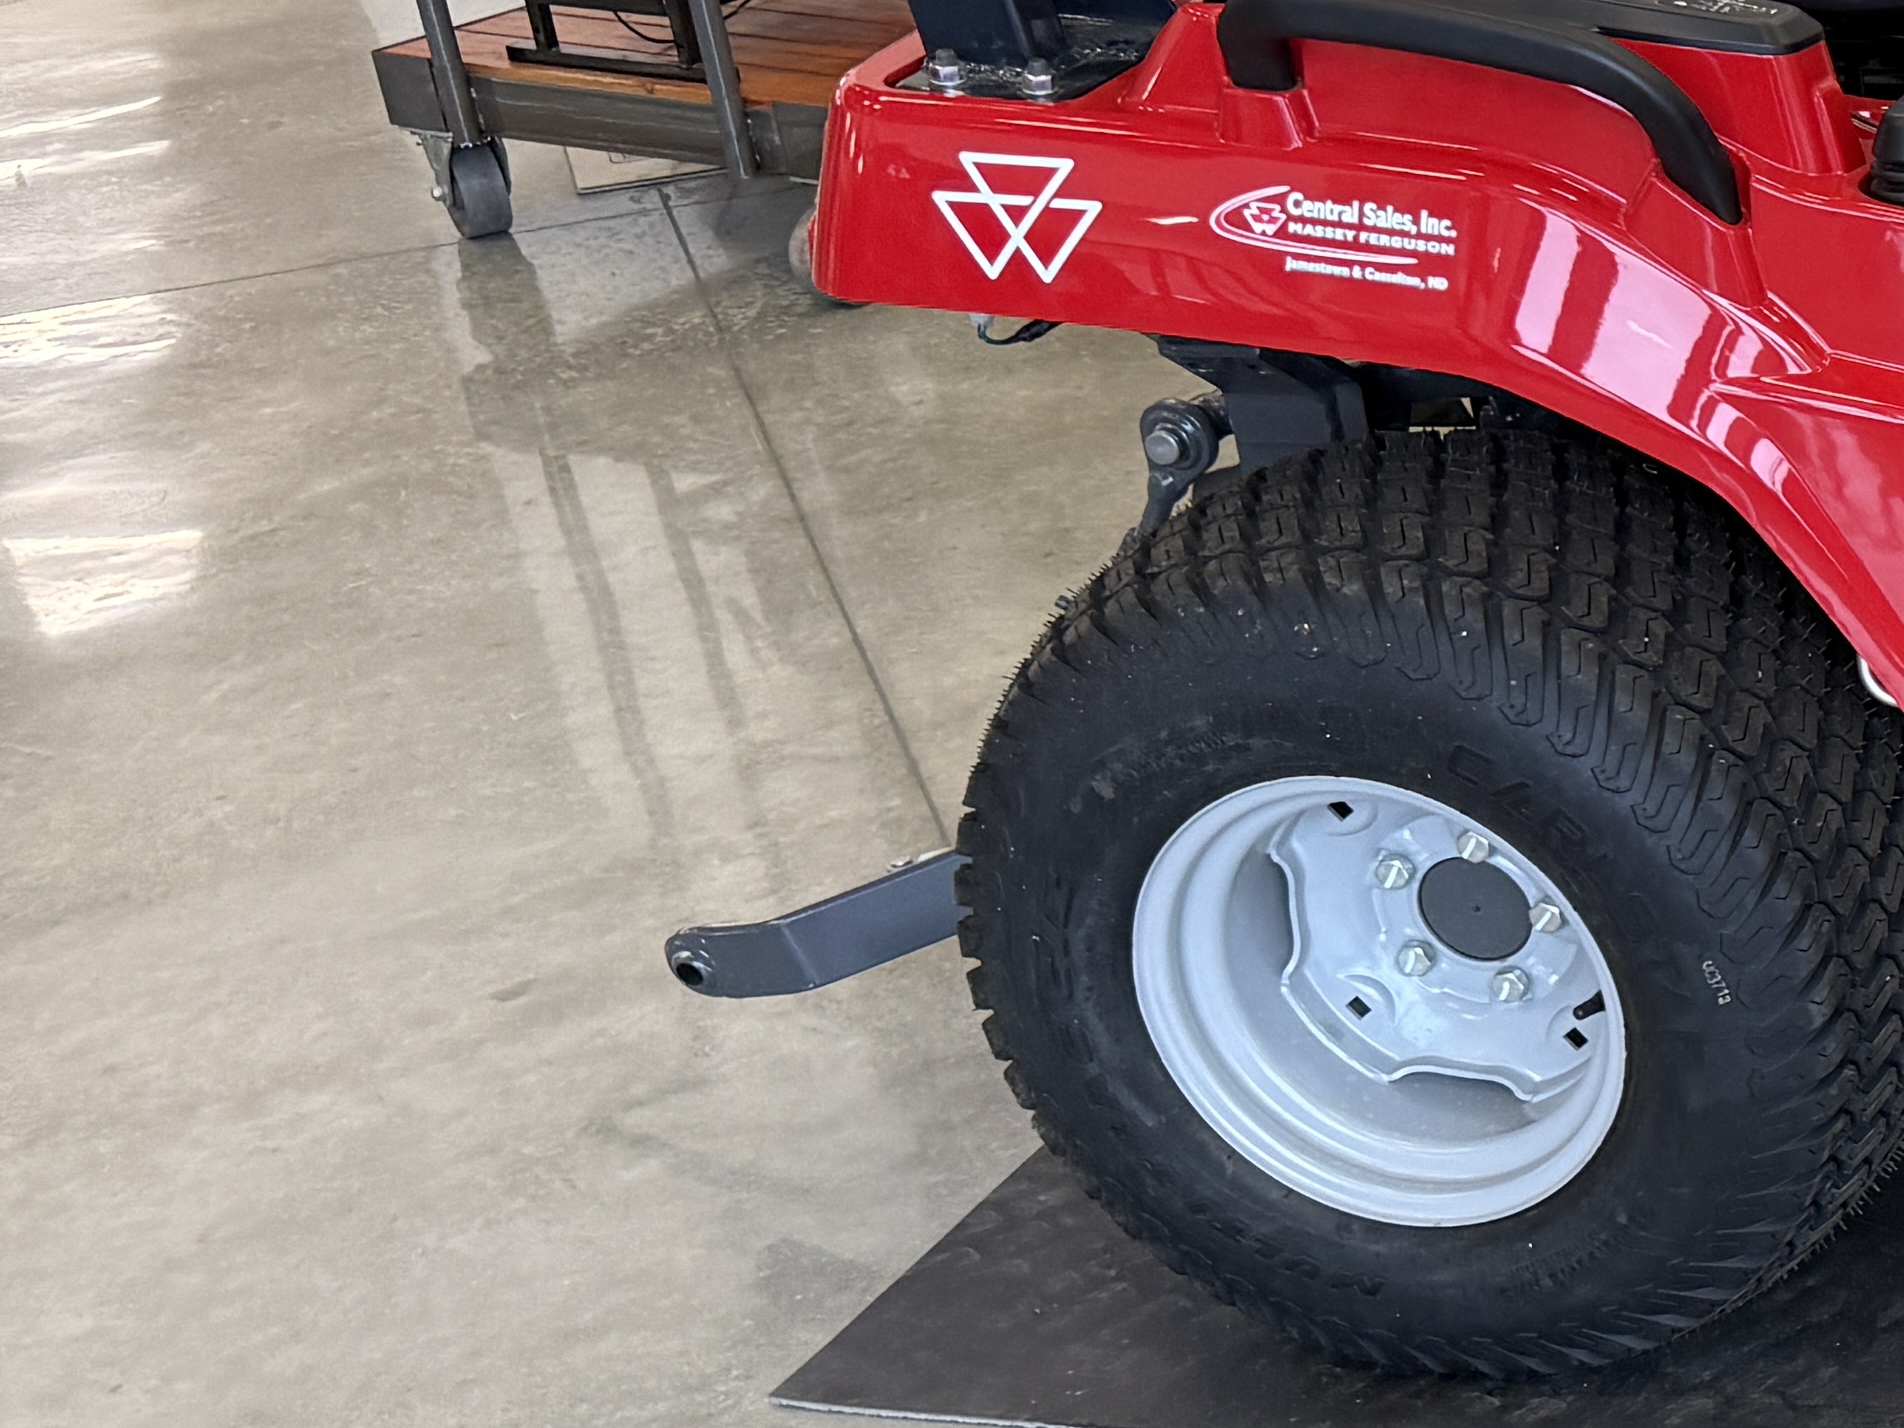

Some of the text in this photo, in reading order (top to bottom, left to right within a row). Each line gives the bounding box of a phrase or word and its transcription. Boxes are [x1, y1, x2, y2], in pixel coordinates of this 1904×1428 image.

[1286, 191, 1458, 238] Central Sales, Inc.
[1287, 222, 1456, 257] MASSEY FERGUSON
[1427, 275, 1449, 291] ND
